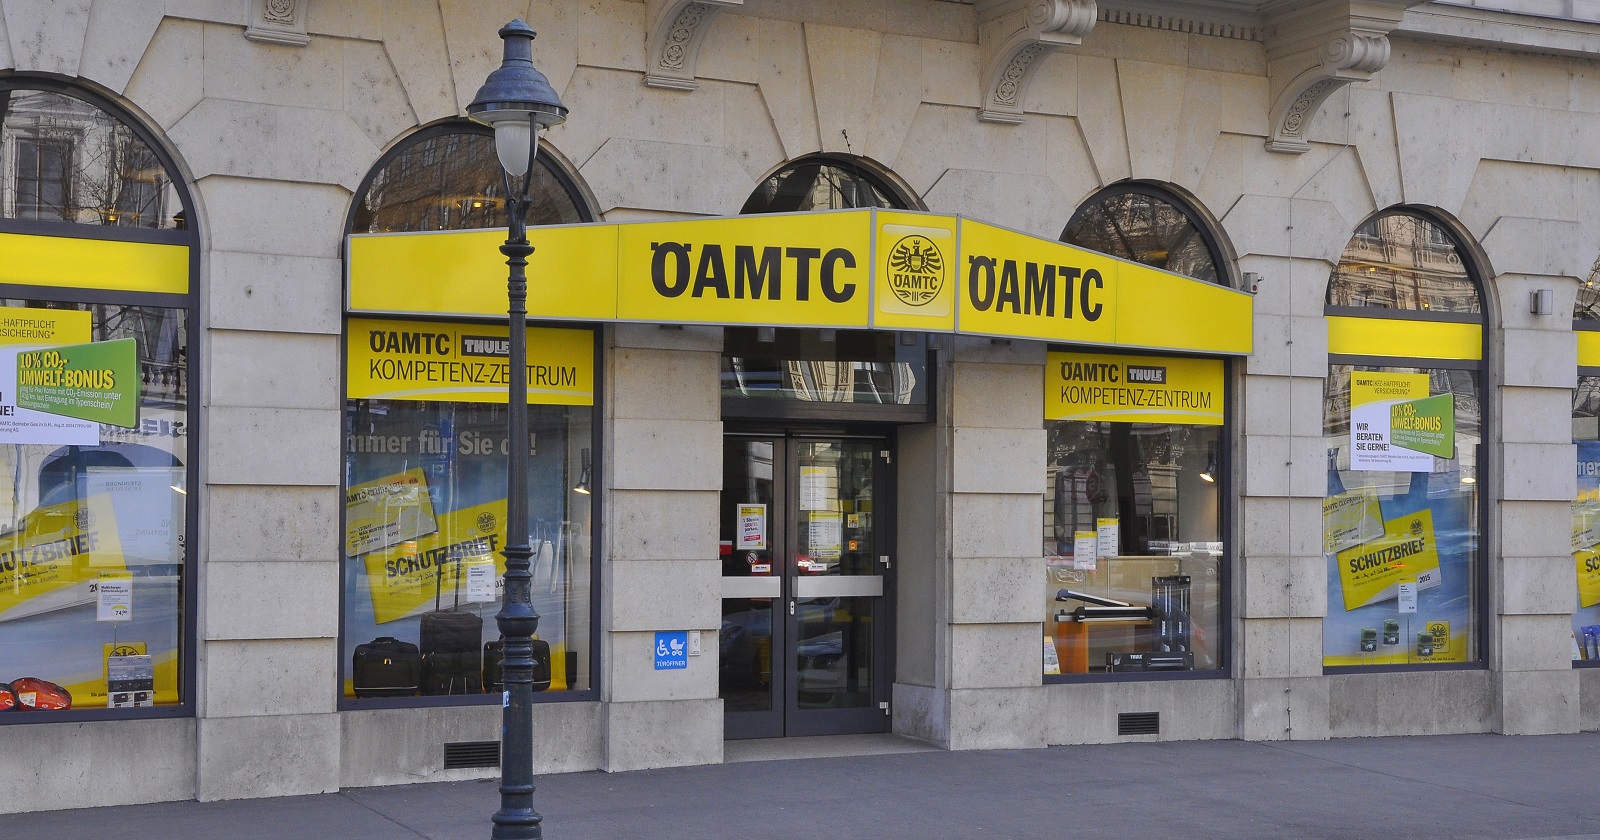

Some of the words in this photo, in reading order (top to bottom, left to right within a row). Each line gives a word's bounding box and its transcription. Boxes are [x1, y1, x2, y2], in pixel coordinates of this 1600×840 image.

[651, 241, 857, 304] ÖAMTC
[893, 273, 938, 290] ÖAMTC
[968, 254, 1104, 322] ÖAMTC
[369, 330, 450, 355] ÖAMTC
[20, 352, 42, 369] 10%
[20, 369, 115, 390] UMWELT-BONUS
[369, 358, 576, 387] KOMPETENZ-ZETRUM
[1060, 361, 1119, 382] ÖAMTC
[1129, 368, 1163, 382] THULE
[103, 391, 122, 401] unter
[1060, 385, 1212, 409] KOMPETENZ-ZENTRUM
[1356, 423, 1369, 431] WIR
[1391, 415, 1442, 431] UMWELT-BONUS
[418, 429, 452, 454] für
[459, 430, 493, 456] Sie
[1356, 433, 1383, 442] BERATEN
[1356, 443, 1367, 451] SIE
[1367, 443, 1390, 452] GERNE!
[384, 533, 499, 579] SCHUTZBRIEF
[1350, 537, 1425, 574] SCHUTZBRIEF
[1418, 574, 1431, 584] 2015
[656, 659, 686, 667] TÜRÖFFNER
